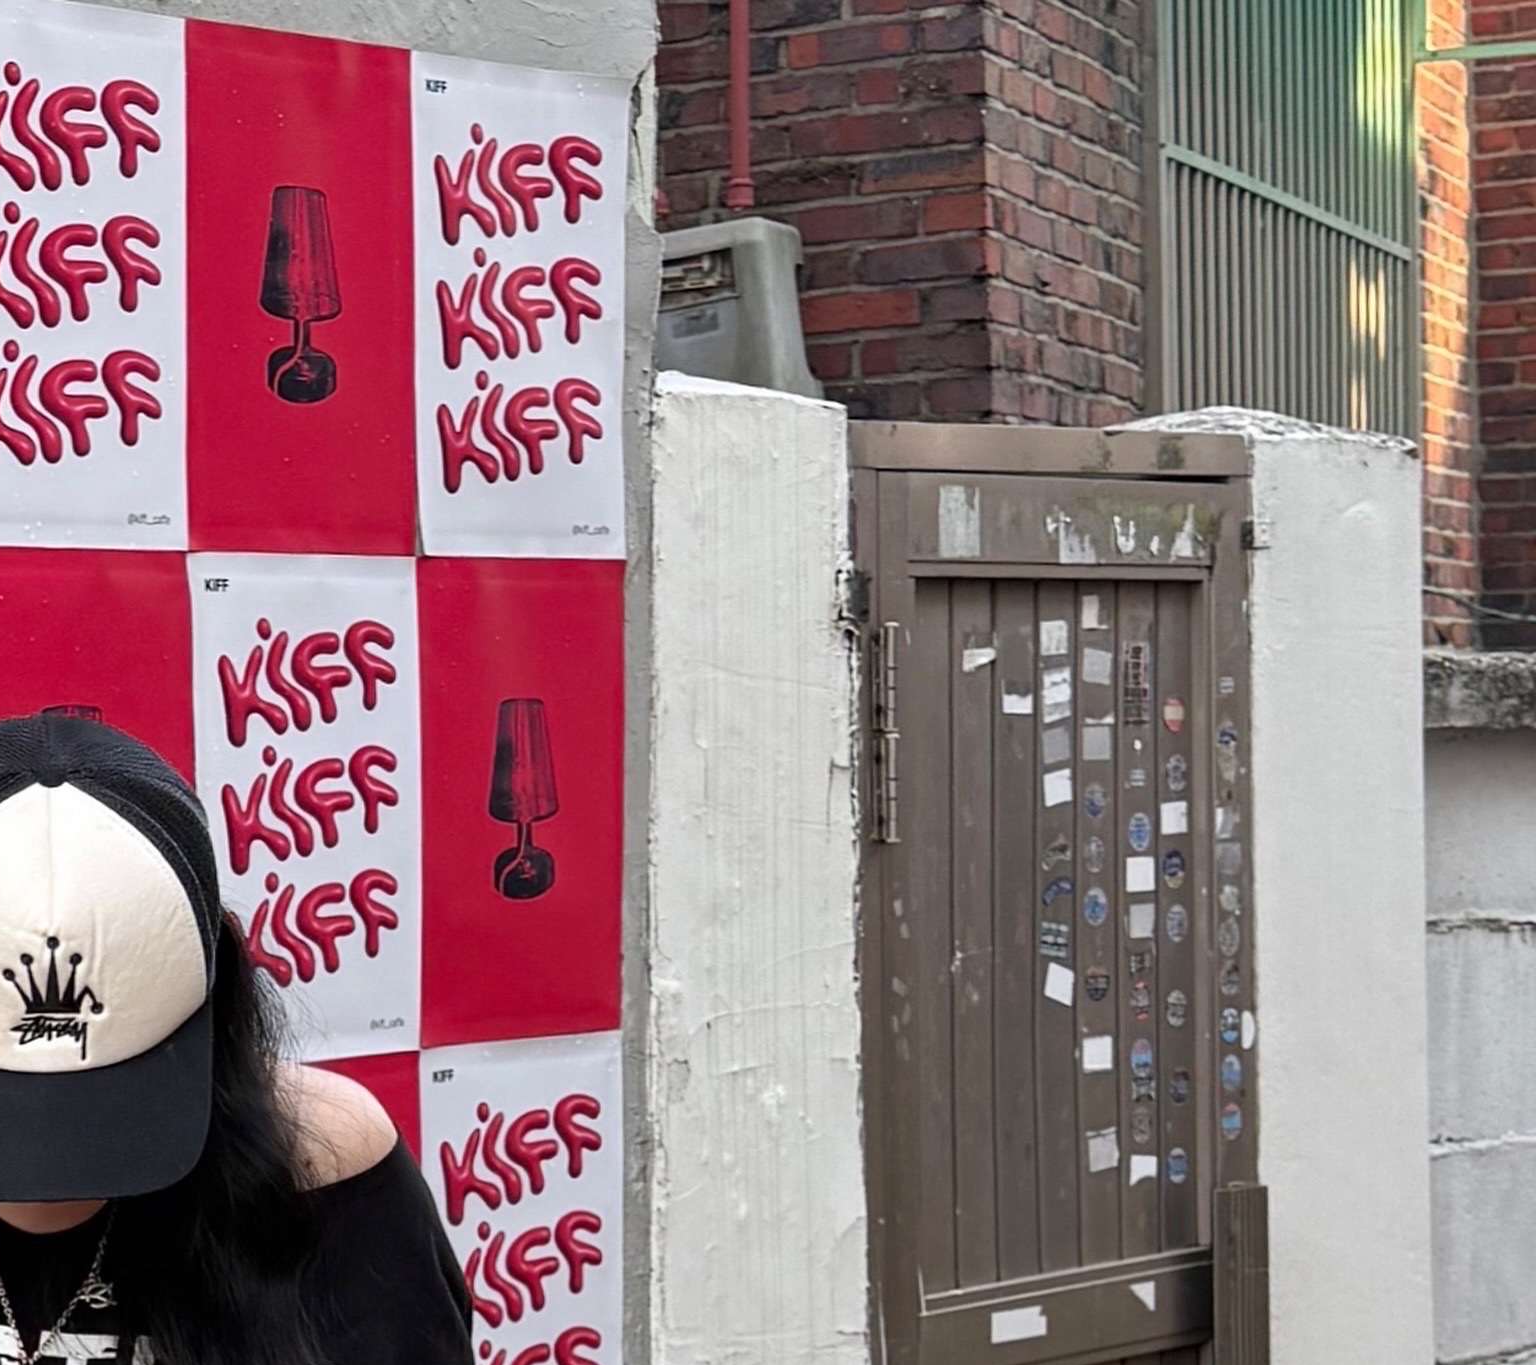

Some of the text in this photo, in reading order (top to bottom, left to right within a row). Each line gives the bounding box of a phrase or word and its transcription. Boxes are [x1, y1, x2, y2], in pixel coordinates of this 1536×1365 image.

[425, 79, 448, 94] KIFF
[203, 577, 230, 593] KIFF
[431, 1068, 454, 1083] KIFF
